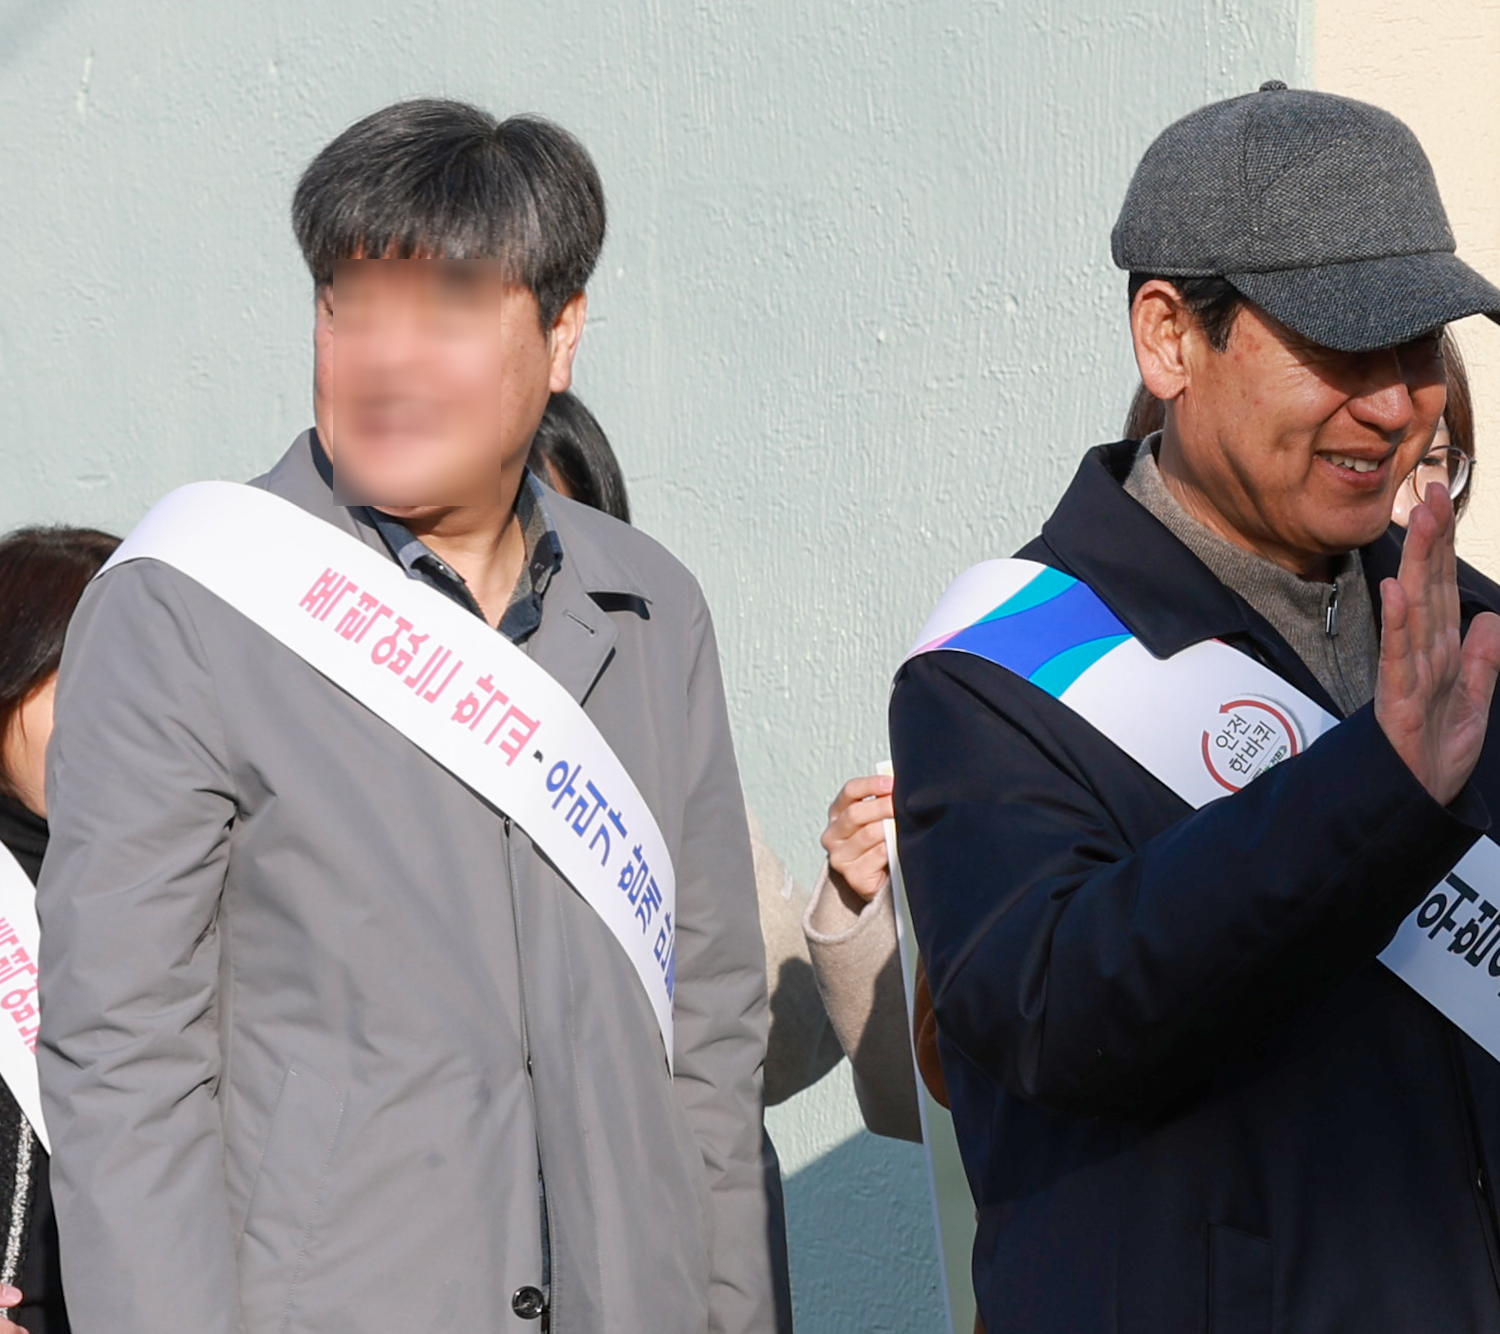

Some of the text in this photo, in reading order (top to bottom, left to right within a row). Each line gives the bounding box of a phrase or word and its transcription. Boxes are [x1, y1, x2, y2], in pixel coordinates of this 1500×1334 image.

[298, 566, 464, 704] 폭력없는
[545, 760, 628, 867] 우리가
[616, 843, 665, 935] 함께
[1214, 712, 1252, 751] 안전
[1227, 719, 1277, 775] 한바퀴
